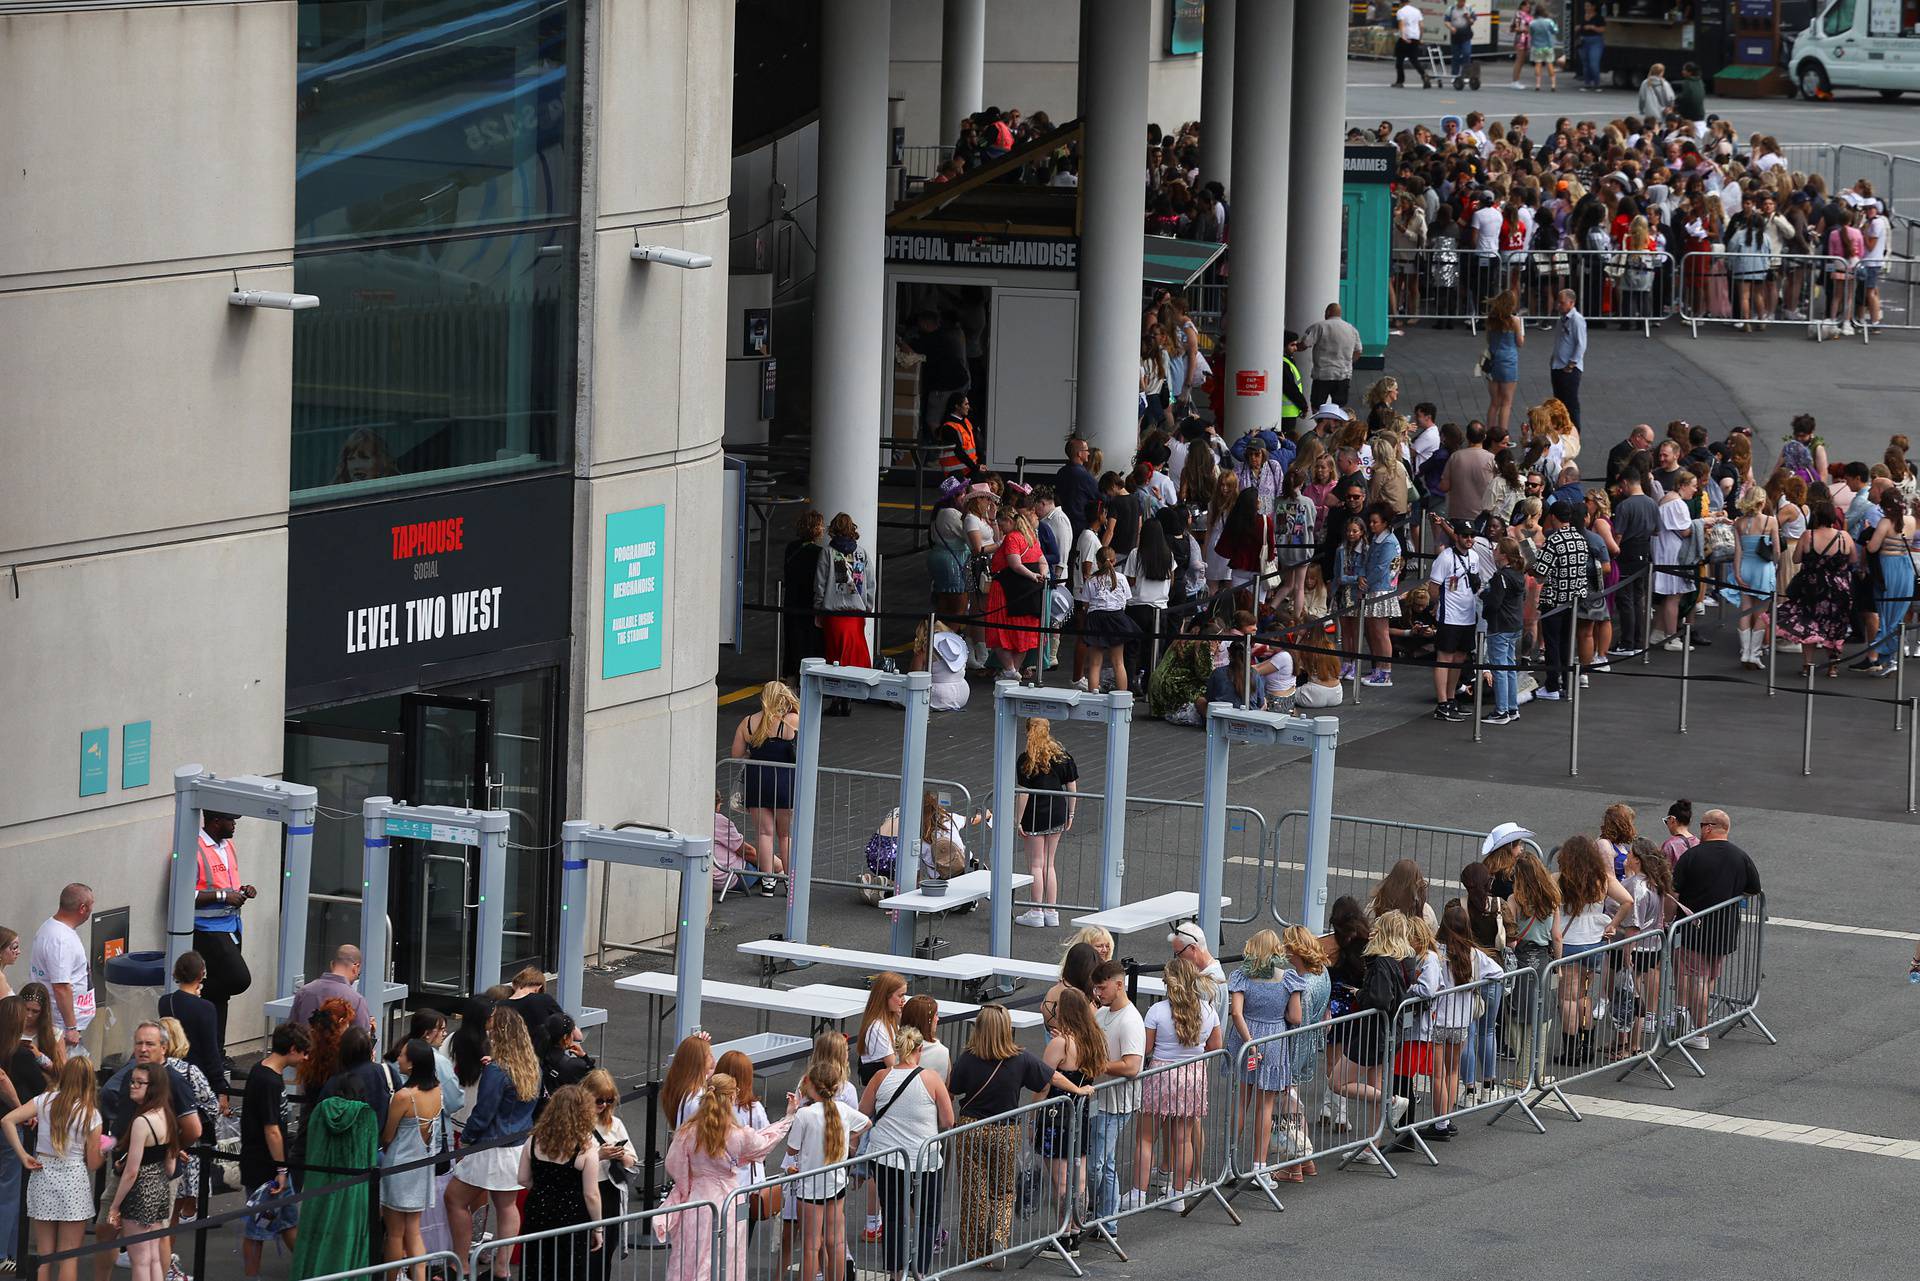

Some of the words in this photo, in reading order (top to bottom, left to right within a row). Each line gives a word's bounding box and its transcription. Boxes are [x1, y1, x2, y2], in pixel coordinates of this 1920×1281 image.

[391, 517, 464, 560] TAPHOUSE
[614, 541, 656, 563] PROGRAMMES
[413, 560, 439, 581] SOCIAL
[628, 562, 641, 578] AND
[613, 577, 655, 599] MERCHANDISE
[347, 604, 399, 653] LEVEL
[405, 596, 446, 644] TWO
[452, 587, 502, 635] WEST
